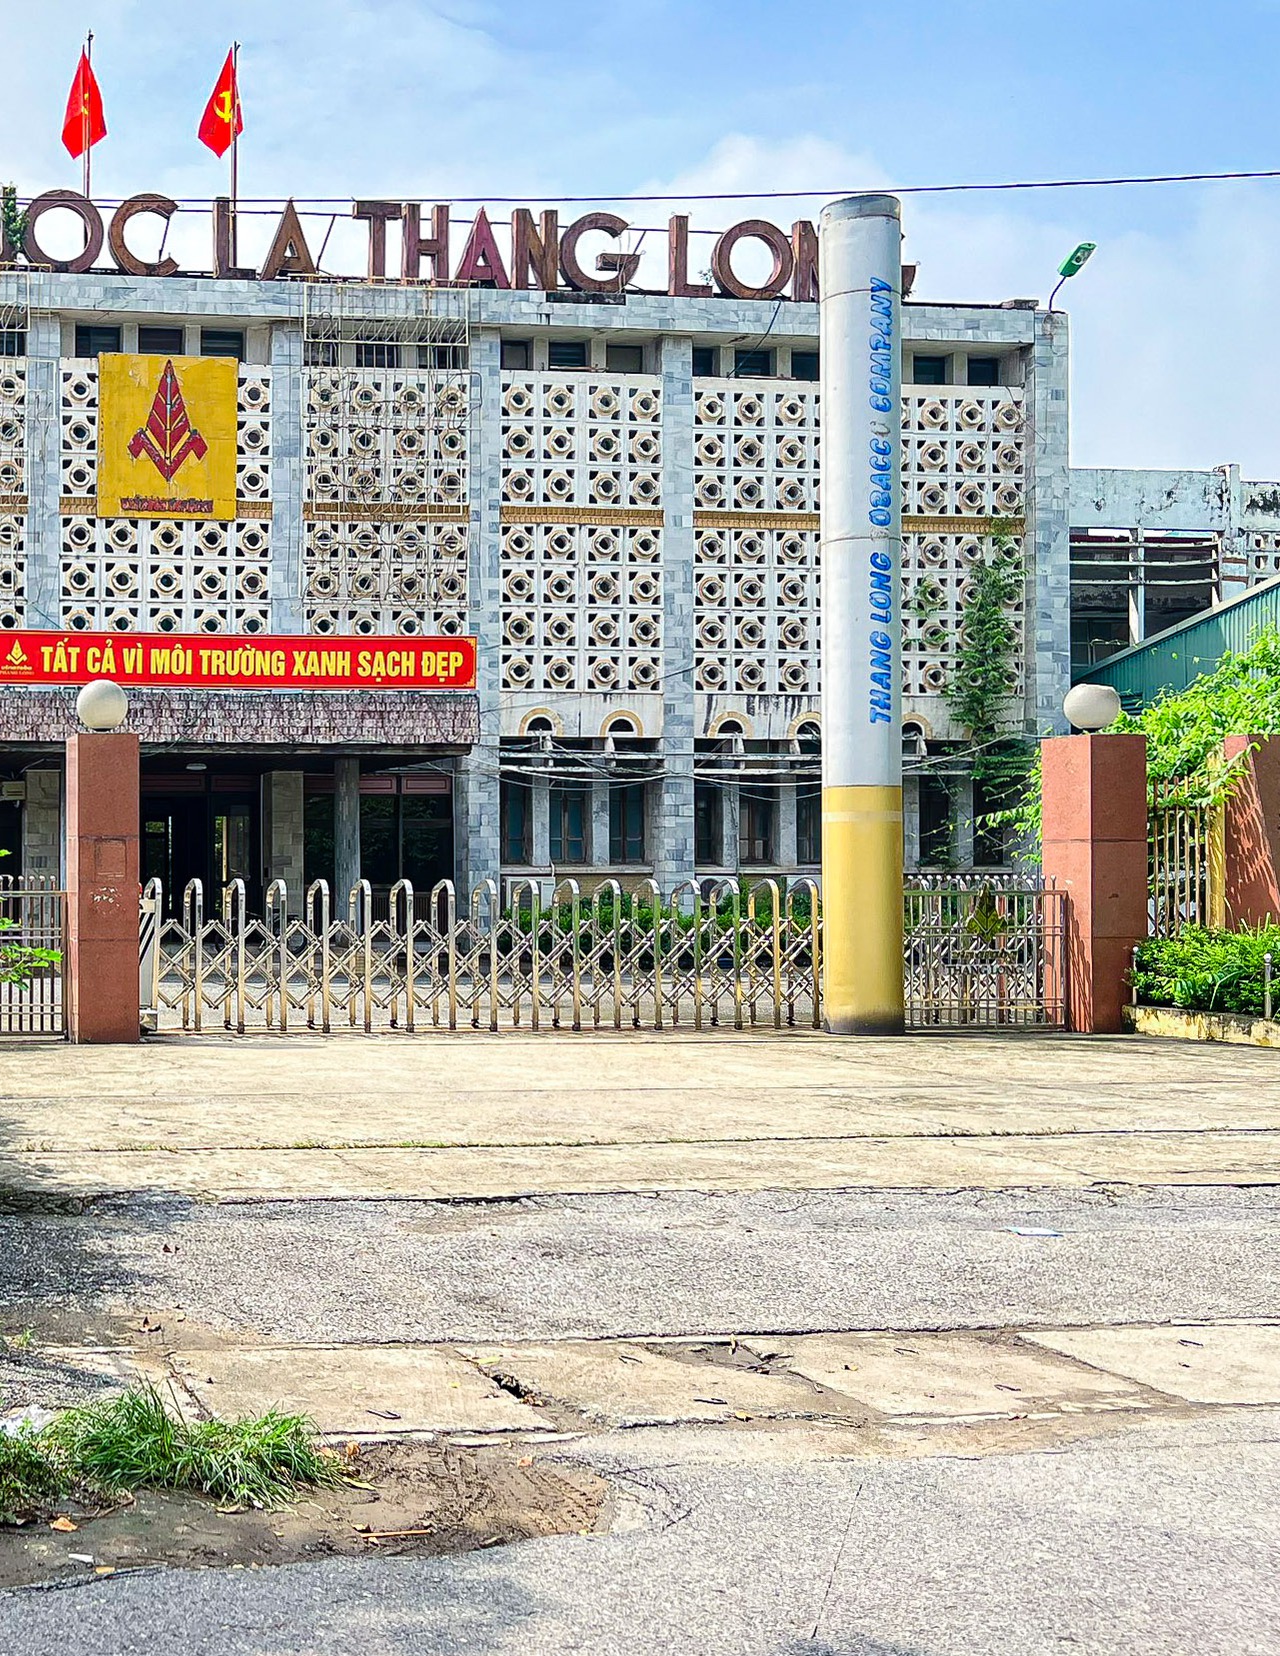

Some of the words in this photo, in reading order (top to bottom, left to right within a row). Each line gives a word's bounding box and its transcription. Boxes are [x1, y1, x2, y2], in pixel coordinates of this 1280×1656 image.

[213, 197, 319, 281] LA
[352, 202, 641, 293] THANG
[668, 215, 916, 302] LON
[869, 277, 892, 413] COMPANY
[869, 421, 892, 540] OBACC
[870, 552, 892, 624] LONG
[41, 637, 81, 673] TẤT
[86, 638, 117, 674] CẢ
[122, 644, 143, 675] VÌ
[150, 643, 193, 675] MÔI
[199, 643, 286, 677] TRƯỜNG
[292, 651, 351, 677] XANH
[357, 651, 415, 683] SẠCH
[421, 652, 464, 683] ĐẸP
[870, 631, 892, 725] THANG
